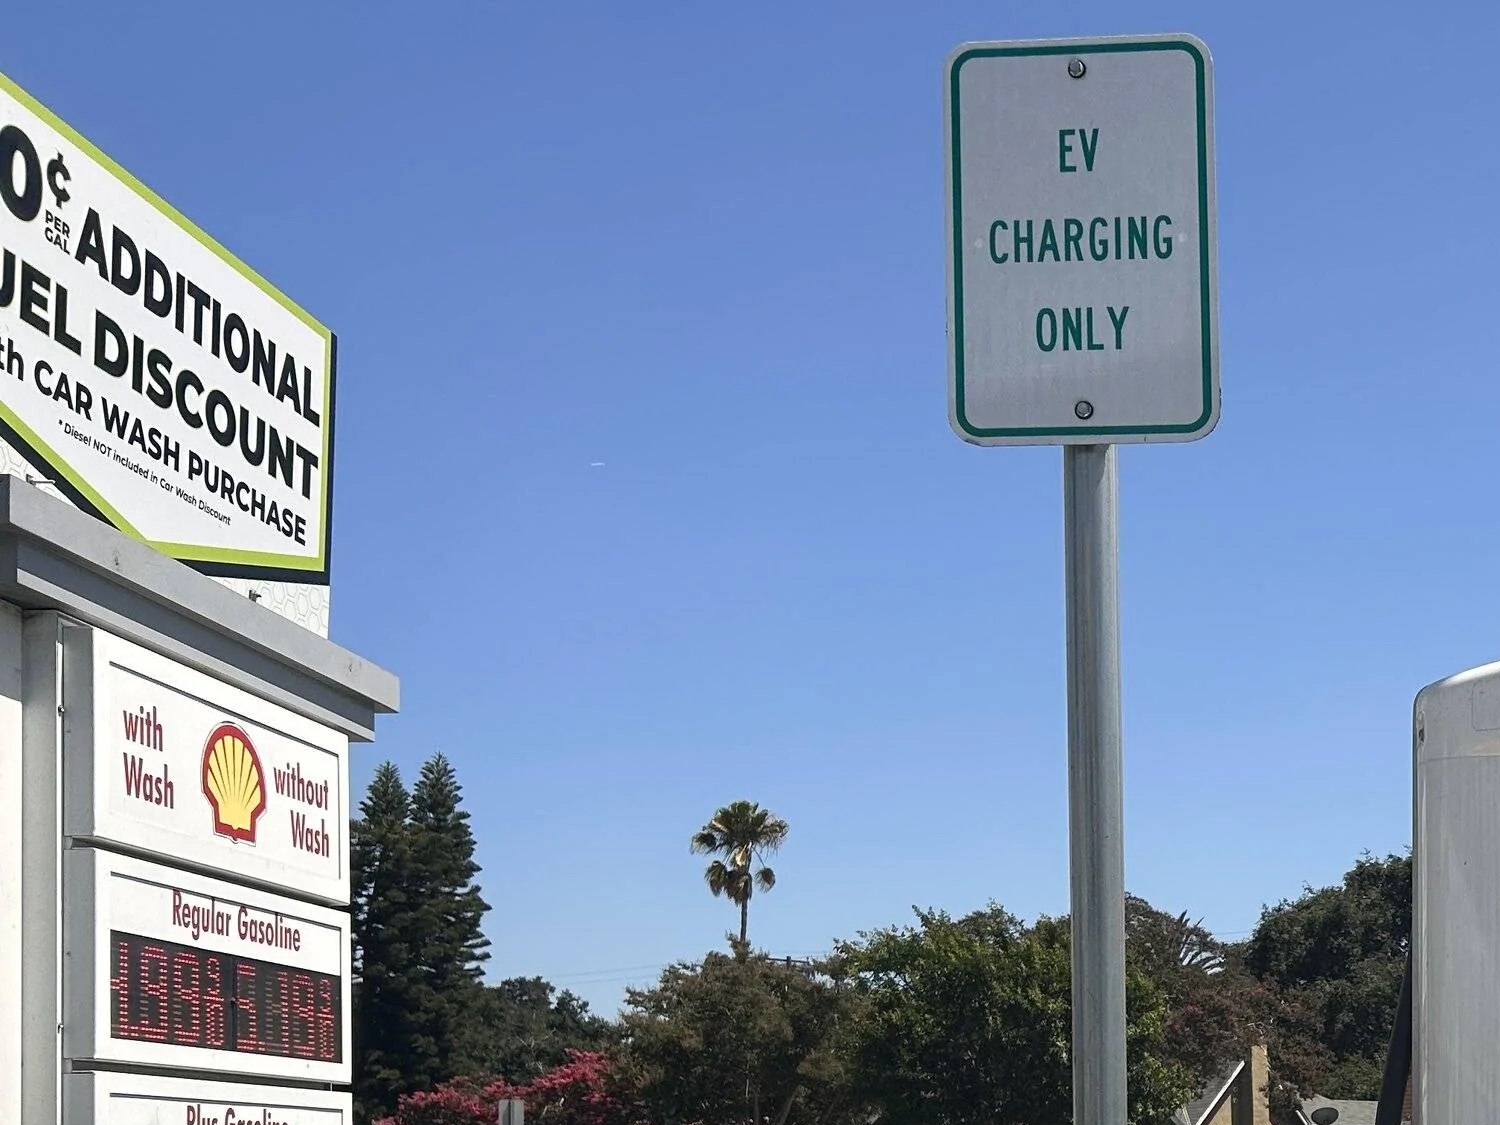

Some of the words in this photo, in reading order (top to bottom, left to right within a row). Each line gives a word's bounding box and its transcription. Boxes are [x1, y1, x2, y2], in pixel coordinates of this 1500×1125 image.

[1059, 127, 1099, 172] EV
[44, 209, 70, 239] PER
[44, 227, 71, 255] GAL
[989, 214, 1173, 264] CHARGING
[75, 207, 320, 427] ADDITIONAL
[1036, 306, 1129, 352] ONLY
[94, 310, 319, 499] DISCOUNT
[34, 360, 92, 422] CAR
[102, 397, 180, 472] WASH
[188, 450, 306, 546] PURCHASE
[64, 423, 92, 446] Diesel
[93, 441, 112, 458] NOT
[113, 450, 150, 479] included
[150, 471, 159, 485] in
[160, 478, 175, 492] Car
[175, 486, 197, 507] Wash
[198, 500, 231, 526] Discount
[123, 706, 163, 752] with
[123, 752, 175, 810] Wash
[274, 762, 329, 812] without
[291, 810, 330, 859] Wash
[172, 888, 232, 940] Regular
[237, 905, 301, 952] Gasoline
